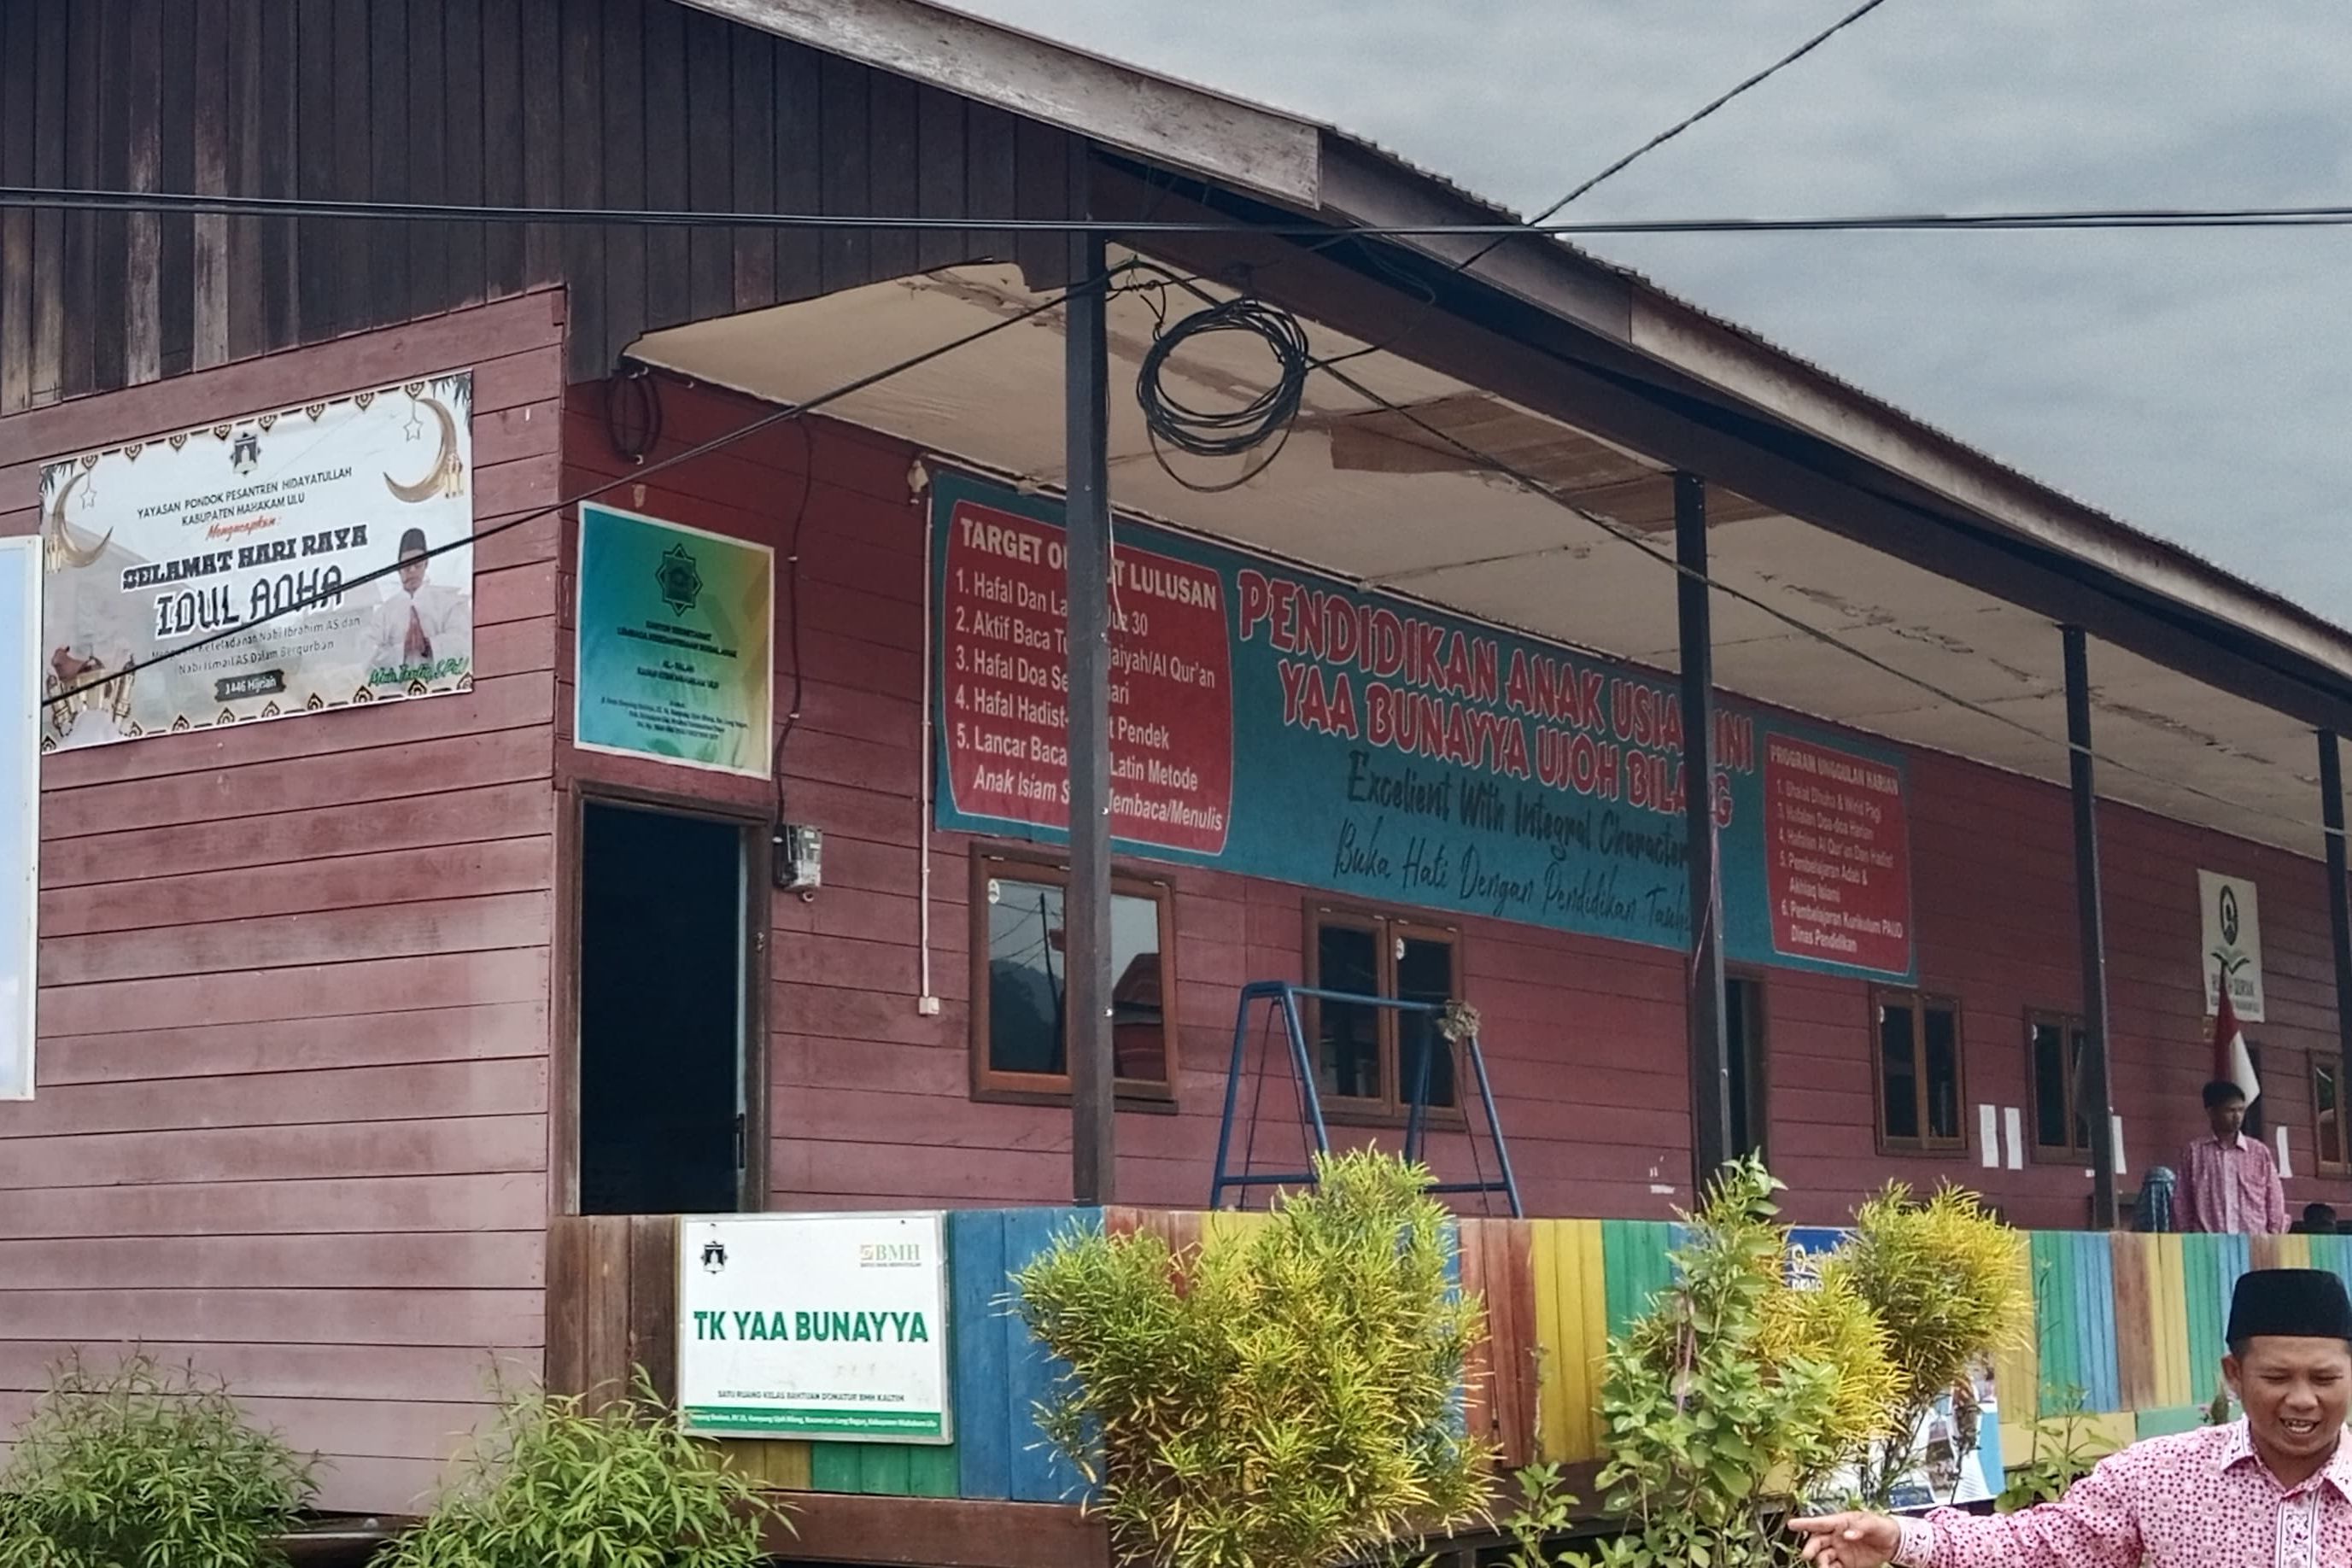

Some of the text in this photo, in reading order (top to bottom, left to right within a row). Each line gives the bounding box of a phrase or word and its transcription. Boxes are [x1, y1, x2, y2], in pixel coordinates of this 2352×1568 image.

[137, 466, 352, 518] YAYASAN PONDOK PESANTREN HIDAYATULLAH
[182, 493, 305, 526] KABUPATEN MAHAKAM ULU
[123, 524, 367, 589] SELAMAT HARI RAYA
[960, 518, 1042, 565] TARGET
[1131, 564, 1216, 611] LULUSAN
[157, 565, 342, 636] IDUL ADHA
[260, 629, 282, 641] Nabi
[284, 624, 323, 639] Ibrahim
[325, 619, 338, 629] AS
[342, 615, 360, 629] dan
[957, 568, 968, 594] 1.
[974, 572, 1013, 604] Hafal
[1017, 582, 1046, 612] Dan
[1132, 611, 1148, 636] 30
[235, 655, 249, 665] AS
[250, 649, 278, 664] Dalam
[956, 606, 969, 633] 2.
[973, 610, 1010, 641] Aktif
[1014, 619, 1050, 650] Baca
[1170, 657, 1214, 688] Qur'an
[956, 645, 969, 671] 3.
[974, 648, 1013, 680] Hafal
[1018, 658, 1047, 687] Doa
[1237, 568, 1753, 775] PENDIDIKAN ANAK USIA INI
[225, 682, 246, 695] 1446
[955, 684, 969, 711] 4.
[974, 687, 1013, 718] Hafal
[1119, 717, 1169, 750] Pendek
[957, 723, 1198, 791] 5. Lancar Baca Latin Metode
[1278, 659, 1733, 828] YAA BUNAYYA UJOH BILAG
[1770, 744, 1816, 774] PROGRAM
[974, 765, 1014, 794] Anak
[1460, 776, 1506, 833] With
[1515, 791, 1591, 862] Integral
[1333, 815, 1391, 880] Buka
[1403, 836, 1448, 889] Hati
[1460, 842, 1534, 916] Dengan
[1542, 861, 1637, 921] Pendidikan
[1882, 919, 1904, 939] PAUD
[875, 1243, 921, 1261] BMH
[693, 1311, 929, 1343] TK YAA BUNAYYA
